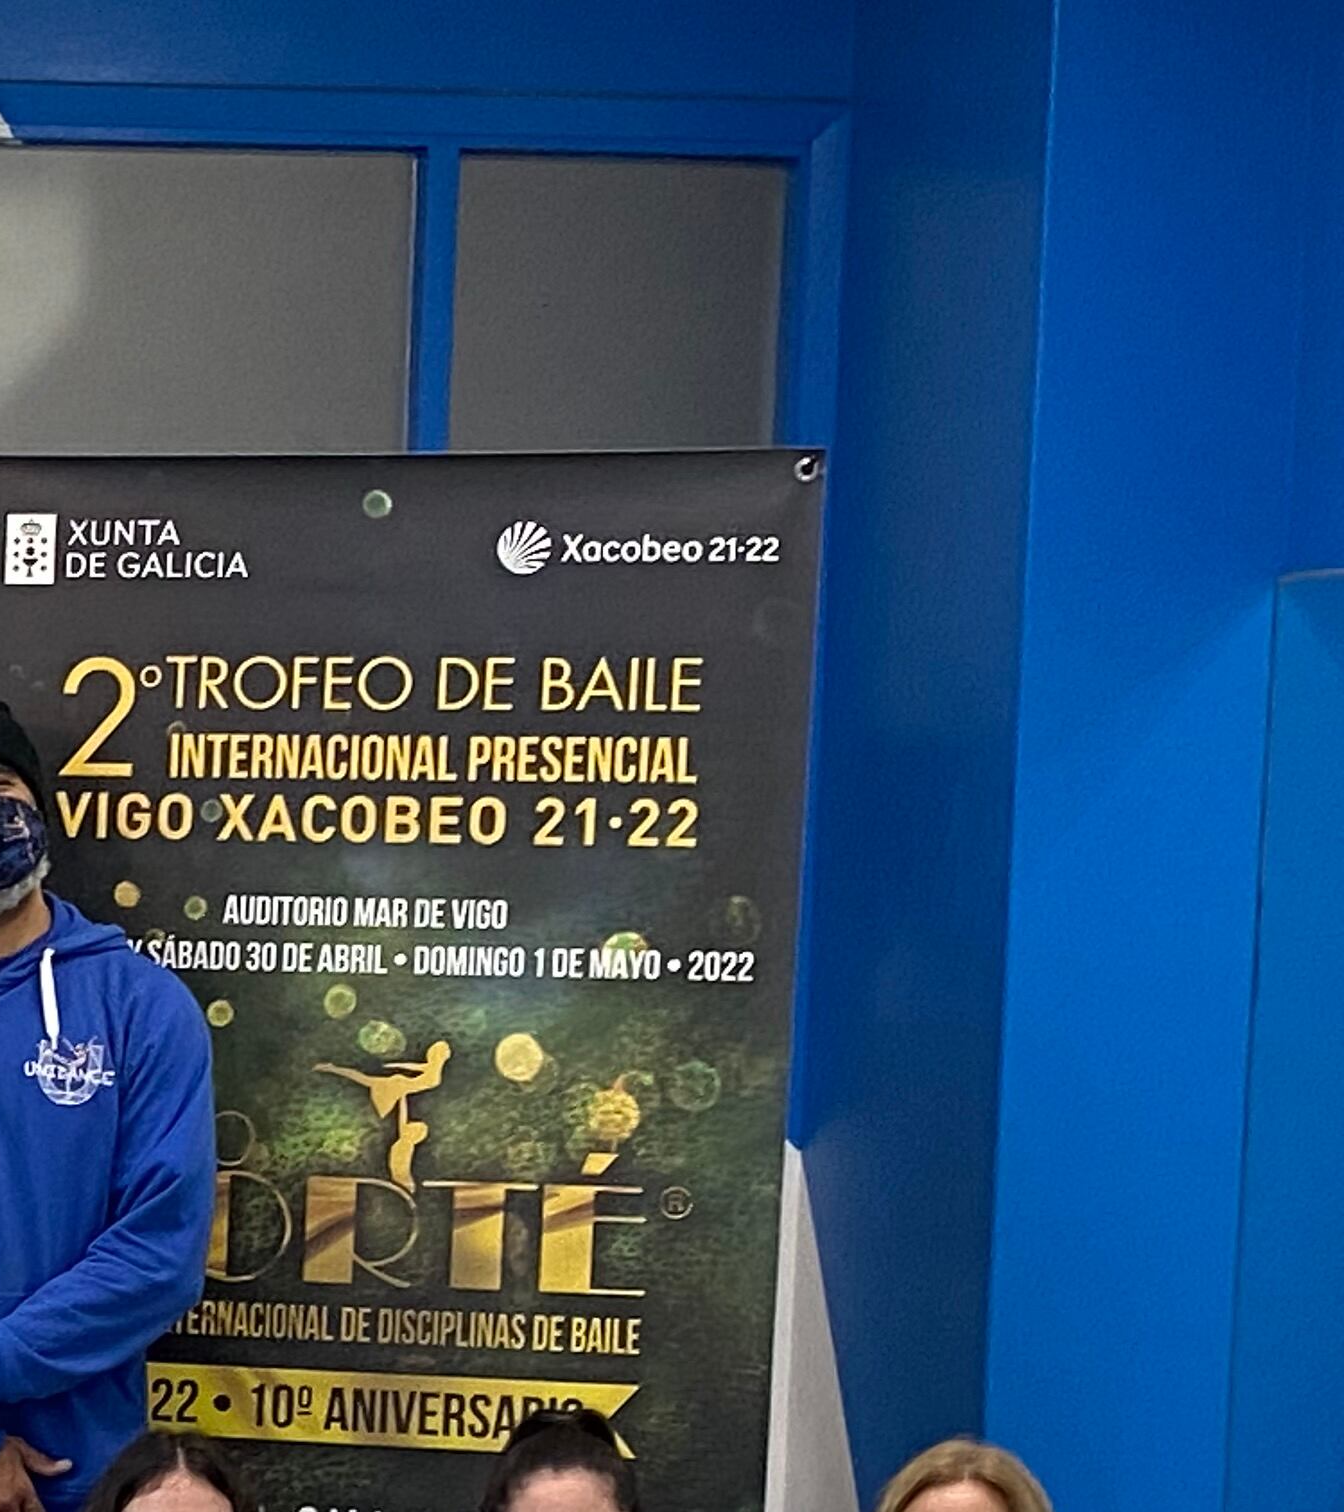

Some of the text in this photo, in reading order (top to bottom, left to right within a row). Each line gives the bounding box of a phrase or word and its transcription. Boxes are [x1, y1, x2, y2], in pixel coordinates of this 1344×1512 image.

[67, 519, 180, 546] XUNTA
[560, 533, 704, 563] Xacobeo
[65, 551, 249, 579] DE GALICIA
[165, 655, 413, 712] TROFEO
[437, 657, 516, 711] DE
[541, 656, 704, 712] BAILE
[169, 733, 698, 784] INTERNACIONAL PRESENCIAL
[56, 791, 193, 840] VIGO
[211, 793, 507, 845] XACOBEO
[222, 894, 508, 930] AUDITORIO MAR DE VIGO
[147, 932, 241, 971] SÁBADO
[245, 941, 277, 972] 30
[282, 942, 314, 973] DE
[316, 943, 388, 975] ABRIL
[413, 945, 526, 978] DOMINGO
[534, 947, 545, 978] 1
[552, 947, 585, 979] DE
[589, 947, 661, 980] MAYO
[688, 950, 754, 982] 2022
[175, 1300, 642, 1355] ERNACIONAL DE DISCIPLINAS DE BAILE
[150, 1377, 199, 1423] 22
[323, 1386, 584, 1439] ANIVERSA
